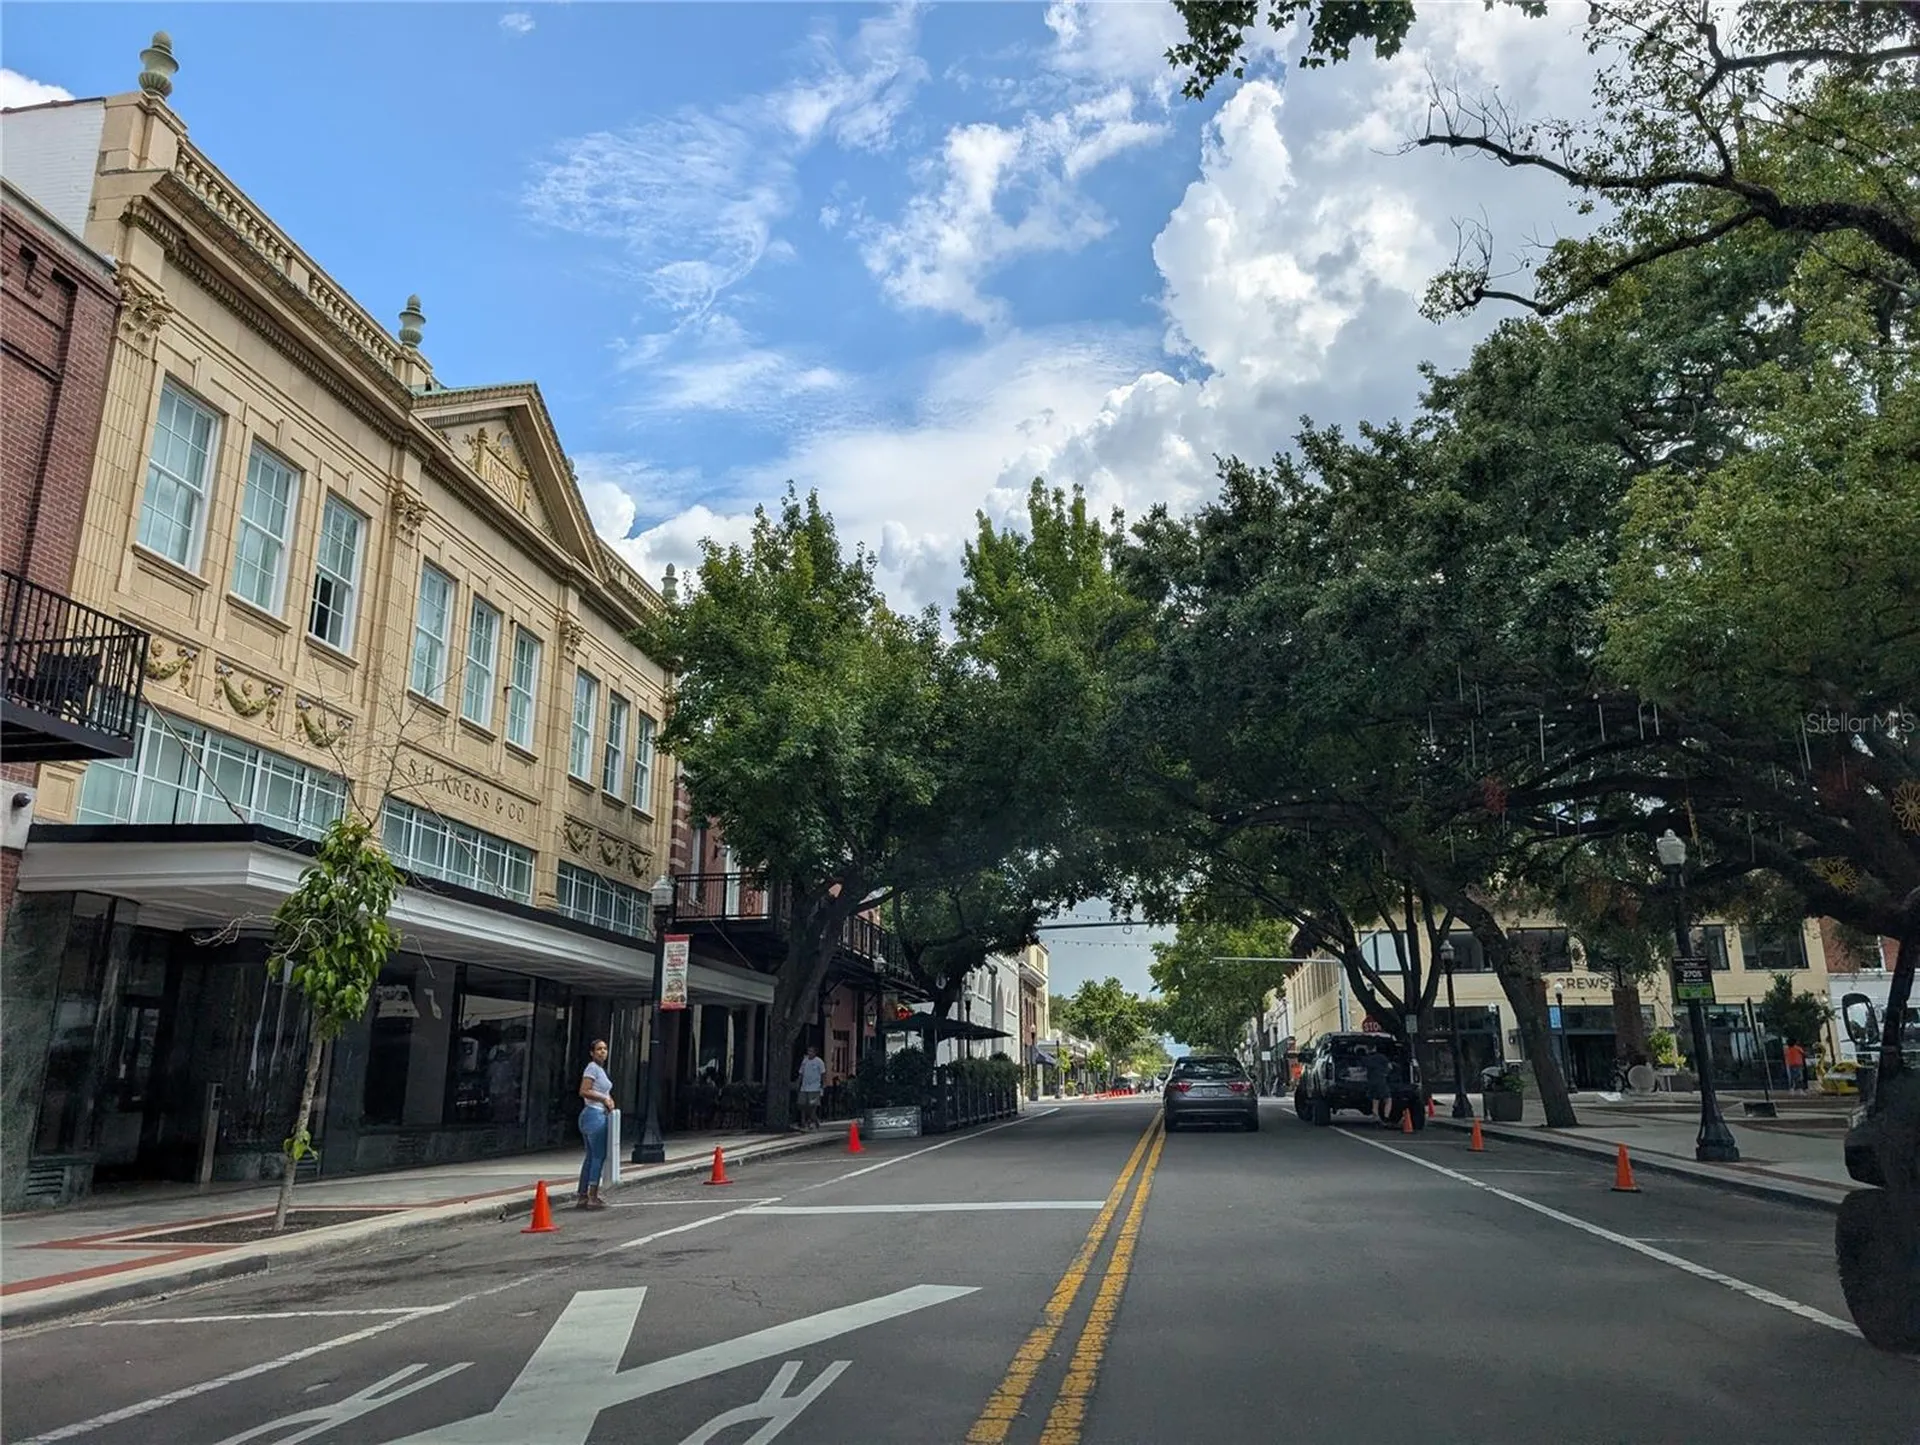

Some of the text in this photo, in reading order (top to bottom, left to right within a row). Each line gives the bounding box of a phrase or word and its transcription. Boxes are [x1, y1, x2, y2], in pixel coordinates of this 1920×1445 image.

[441, 773, 491, 809] KRESS
[495, 797, 503, 814] &
[508, 803, 527, 825] CO.
